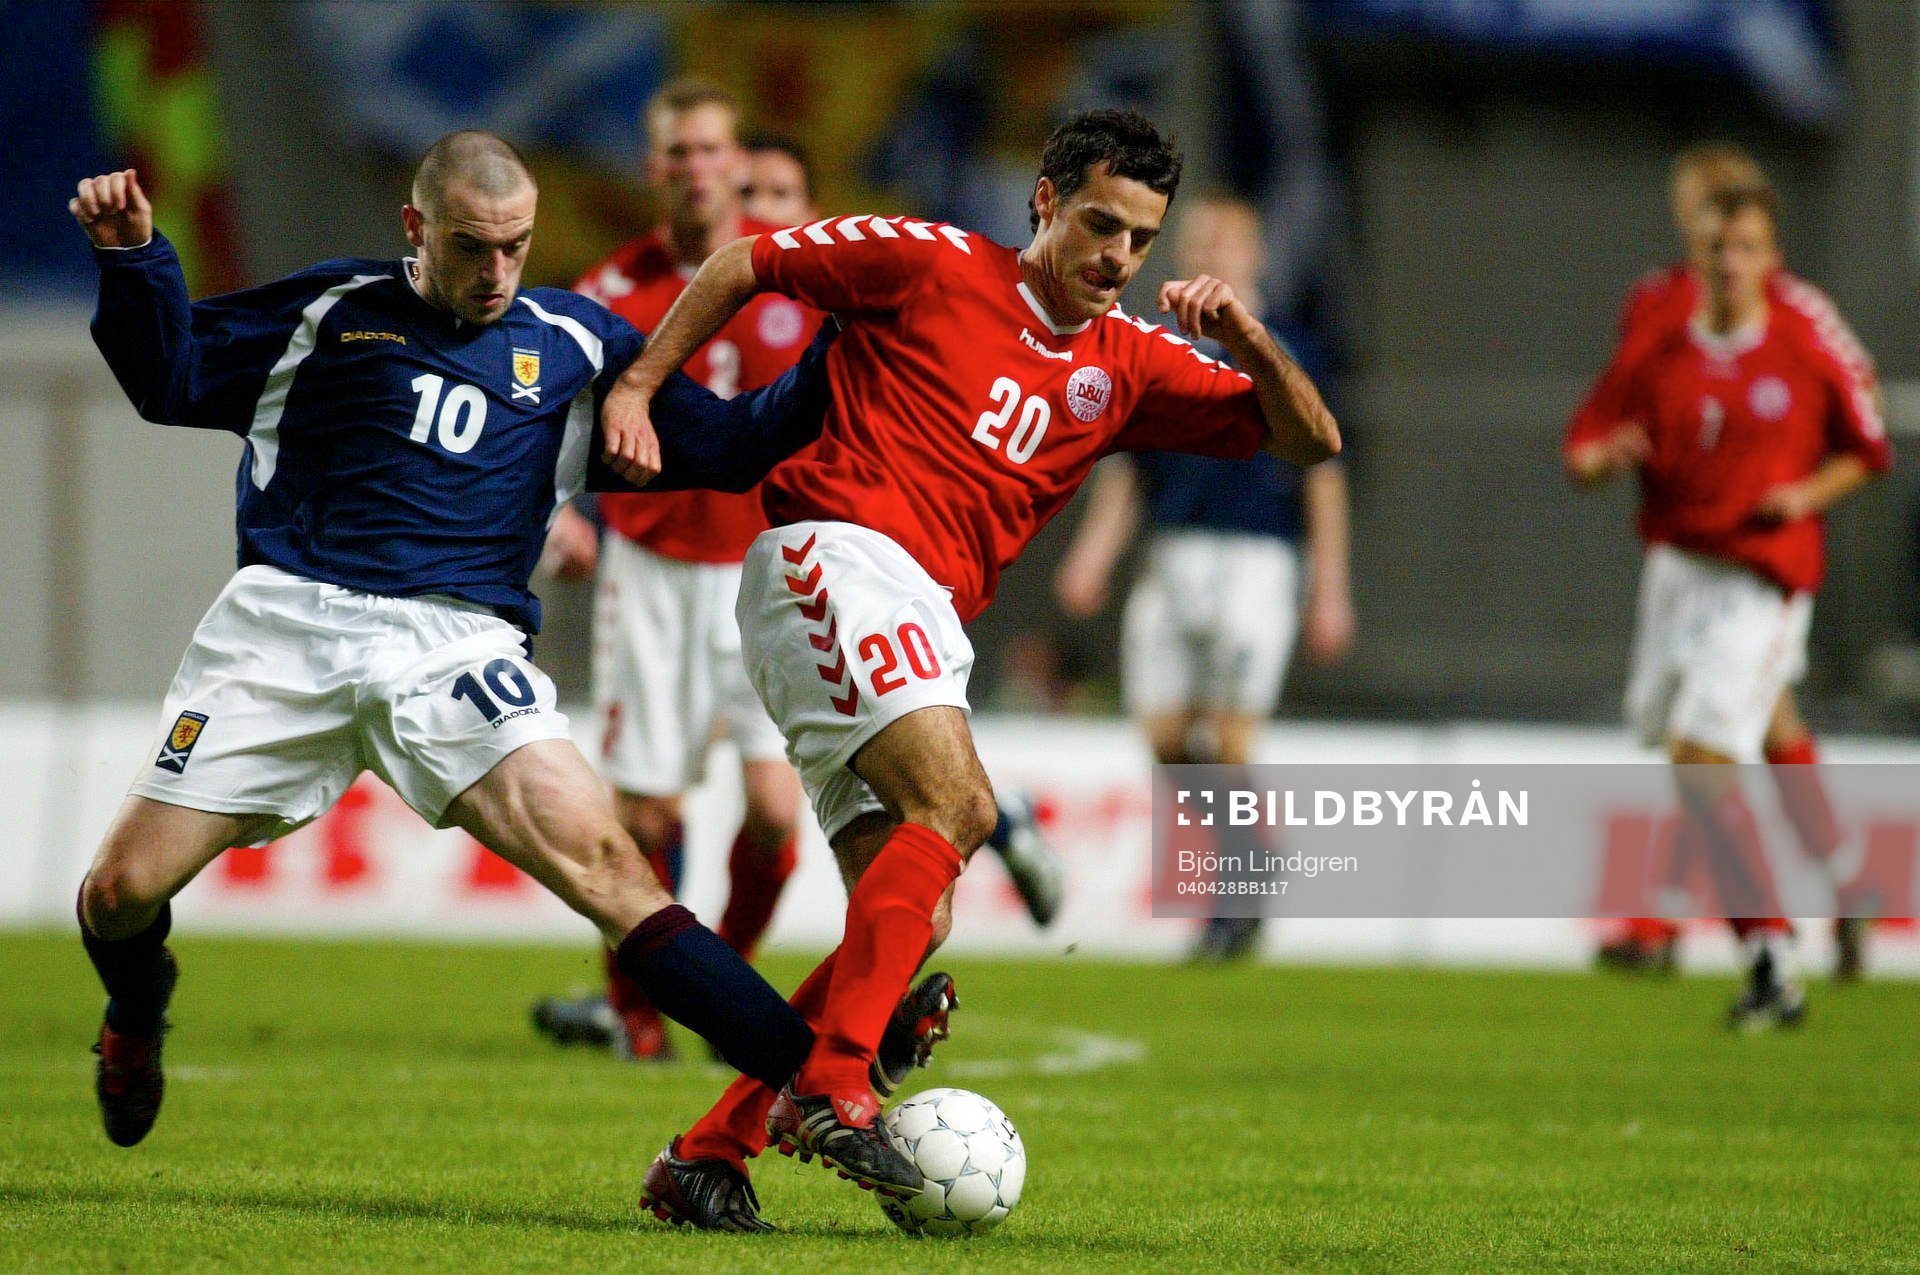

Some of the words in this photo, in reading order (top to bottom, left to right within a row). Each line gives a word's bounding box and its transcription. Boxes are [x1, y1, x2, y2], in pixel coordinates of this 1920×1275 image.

[341, 331, 406, 345] DIADORA
[1019, 328, 1072, 362] huml
[410, 373, 488, 453] 10
[1076, 382, 1104, 404] DBU
[971, 377, 1051, 464] 20
[858, 622, 941, 697] 20
[451, 659, 536, 722] 10
[492, 707, 541, 728] DIADORA
